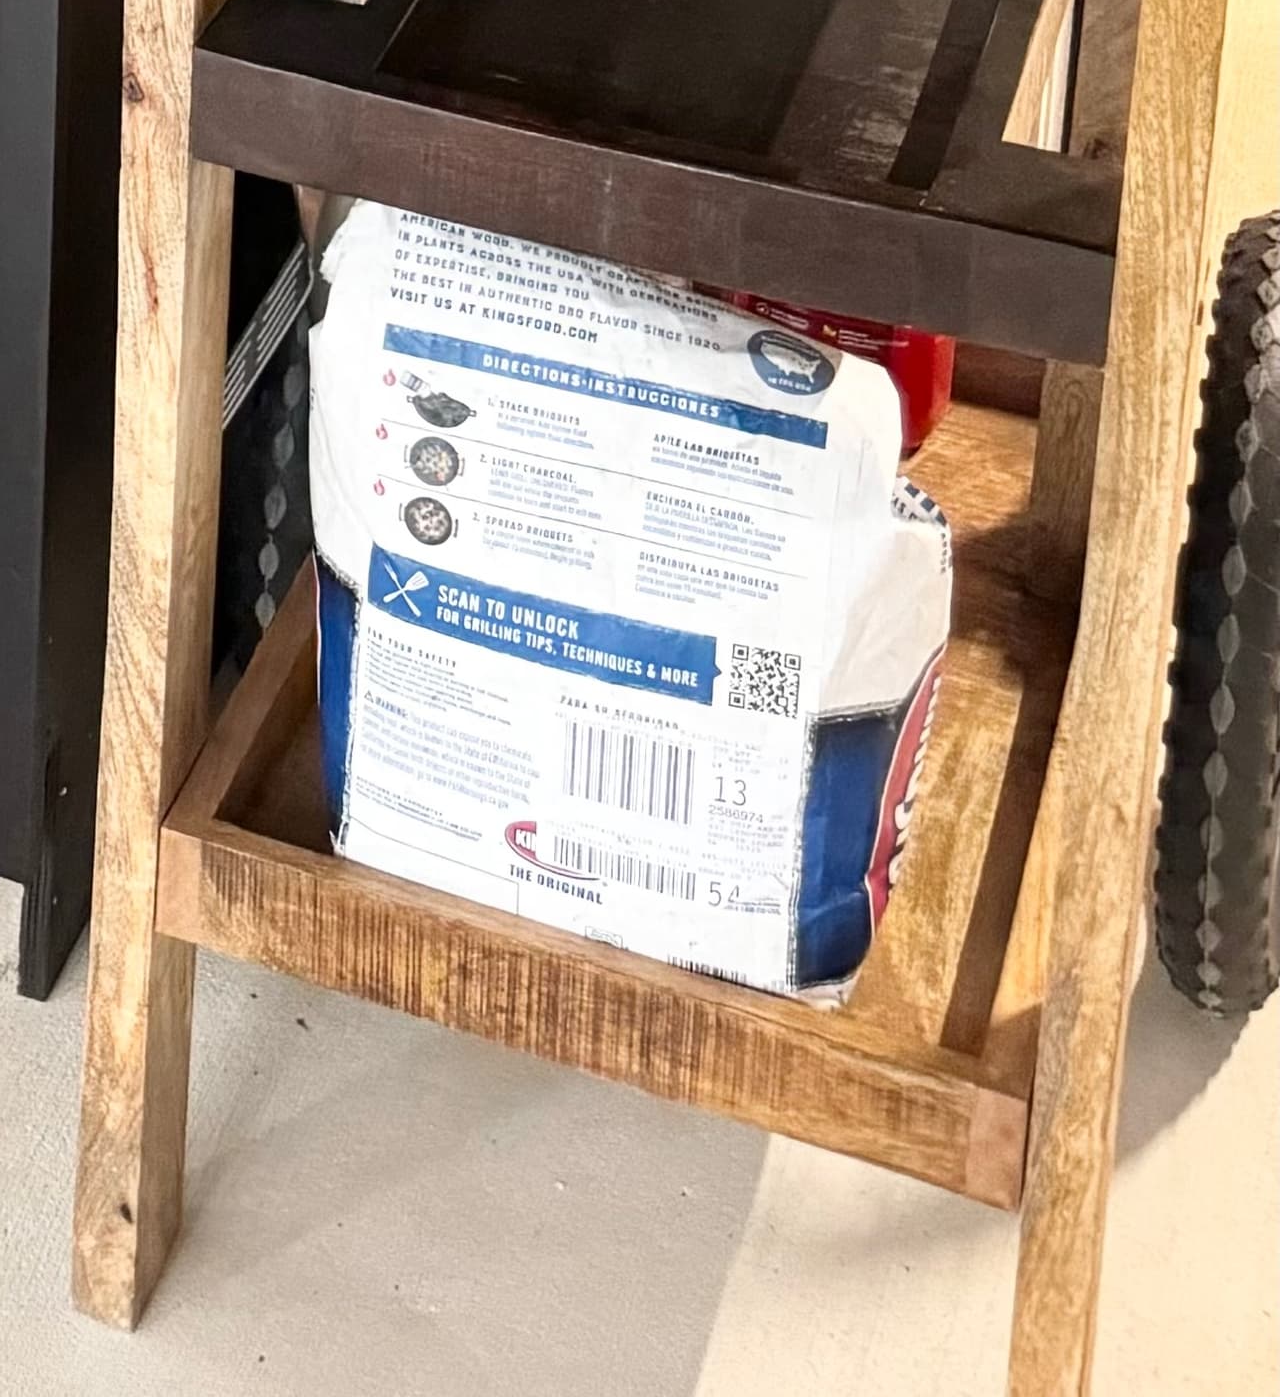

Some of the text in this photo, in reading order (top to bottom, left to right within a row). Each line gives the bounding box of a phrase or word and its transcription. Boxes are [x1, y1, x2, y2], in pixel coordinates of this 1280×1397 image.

[400, 213, 466, 237] AMERICAN
[471, 230, 514, 250] WOOD.
[521, 242, 540, 256] WE
[546, 249, 602, 274] PROUDLY
[395, 249, 590, 301] OF EXPERTISE, BRINGING YOU
[398, 229, 410, 241] IN
[415, 235, 465, 253] PLANTS
[470, 247, 522, 268] ACROSS
[528, 261, 552, 275] THE
[557, 268, 584, 283] USA
[591, 277, 624, 296] WITH
[630, 290, 718, 323] GENERATIONS
[390, 287, 598, 343] VISIT US AT KINGSFORD.COM
[392, 268, 416, 283] THE
[422, 274, 453, 290] BEST
[459, 282, 472, 294] IN
[478, 287, 553, 311] AUTHENTIC
[589, 312, 638, 331] FLAVOR
[643, 324, 682, 342] SINCE
[500, 400, 529, 414] STACK
[533, 407, 580, 426] BRIQUETS
[653, 433, 760, 466] APILE LAS BRIQUETAS
[492, 457, 520, 470] LIGHT
[523, 464, 577, 484] CHARCOAL.
[647, 491, 692, 510] ENCIENDA
[696, 502, 706, 514] EL
[485, 515, 523, 532] SPREAD
[526, 525, 573, 543] BRIQUETS
[639, 551, 697, 573] DISTRIBUYA
[700, 566, 720, 578] LAS
[723, 571, 779, 592] BRIQUETAS
[437, 585, 580, 641] SCAN TO UNLOCK
[436, 606, 699, 688] FOR GRILLING TIPS, TECHNIQUES & MORE
[560, 695, 588, 709] PARA
[713, 776, 748, 807] 13
[510, 864, 603, 905] THE ORIGINAL
